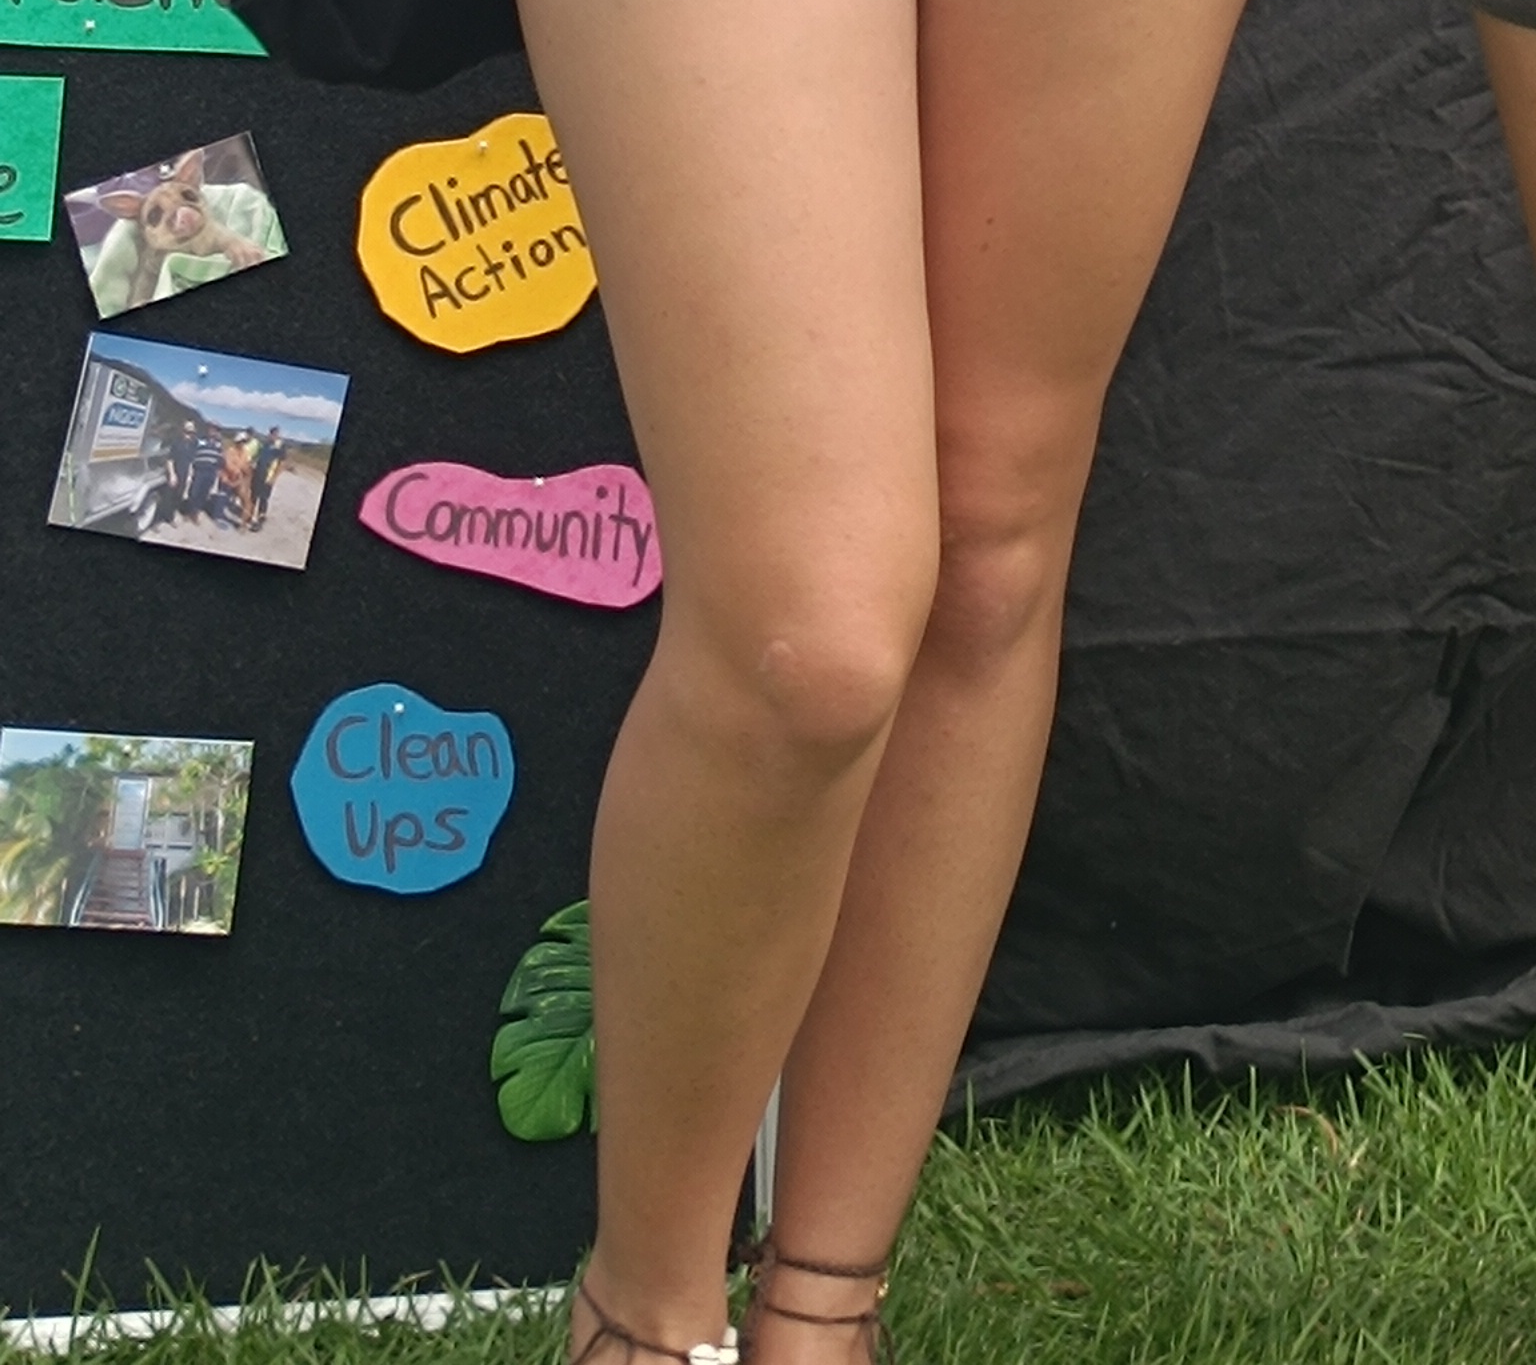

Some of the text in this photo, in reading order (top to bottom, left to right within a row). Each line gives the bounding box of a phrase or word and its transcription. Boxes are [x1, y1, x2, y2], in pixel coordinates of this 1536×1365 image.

[389, 139, 571, 257] Climate
[418, 223, 588, 319] Action
[385, 471, 653, 587] Community
[326, 713, 499, 780] Clean
